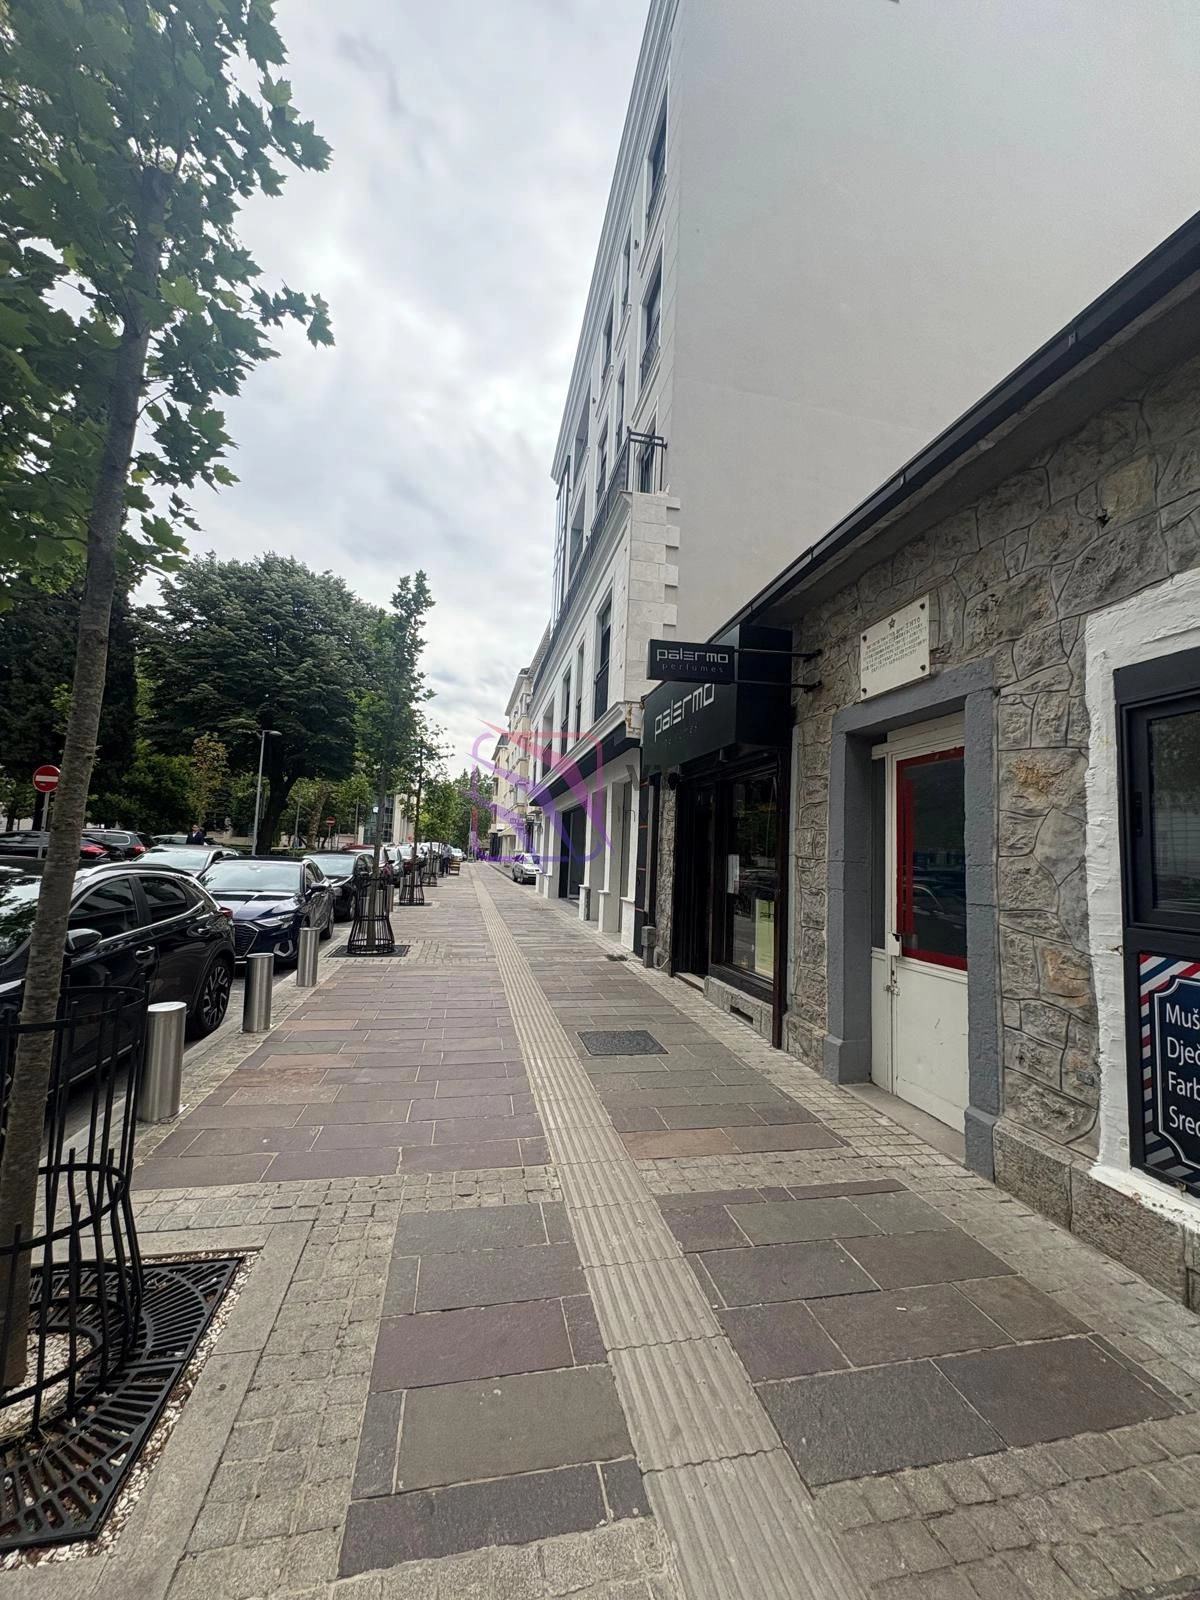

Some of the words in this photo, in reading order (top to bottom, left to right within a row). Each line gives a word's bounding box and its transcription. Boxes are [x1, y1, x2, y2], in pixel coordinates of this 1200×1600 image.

[656, 647, 729, 664] palermo
[662, 663, 724, 673] perfumes
[654, 683, 715, 743] palermo
